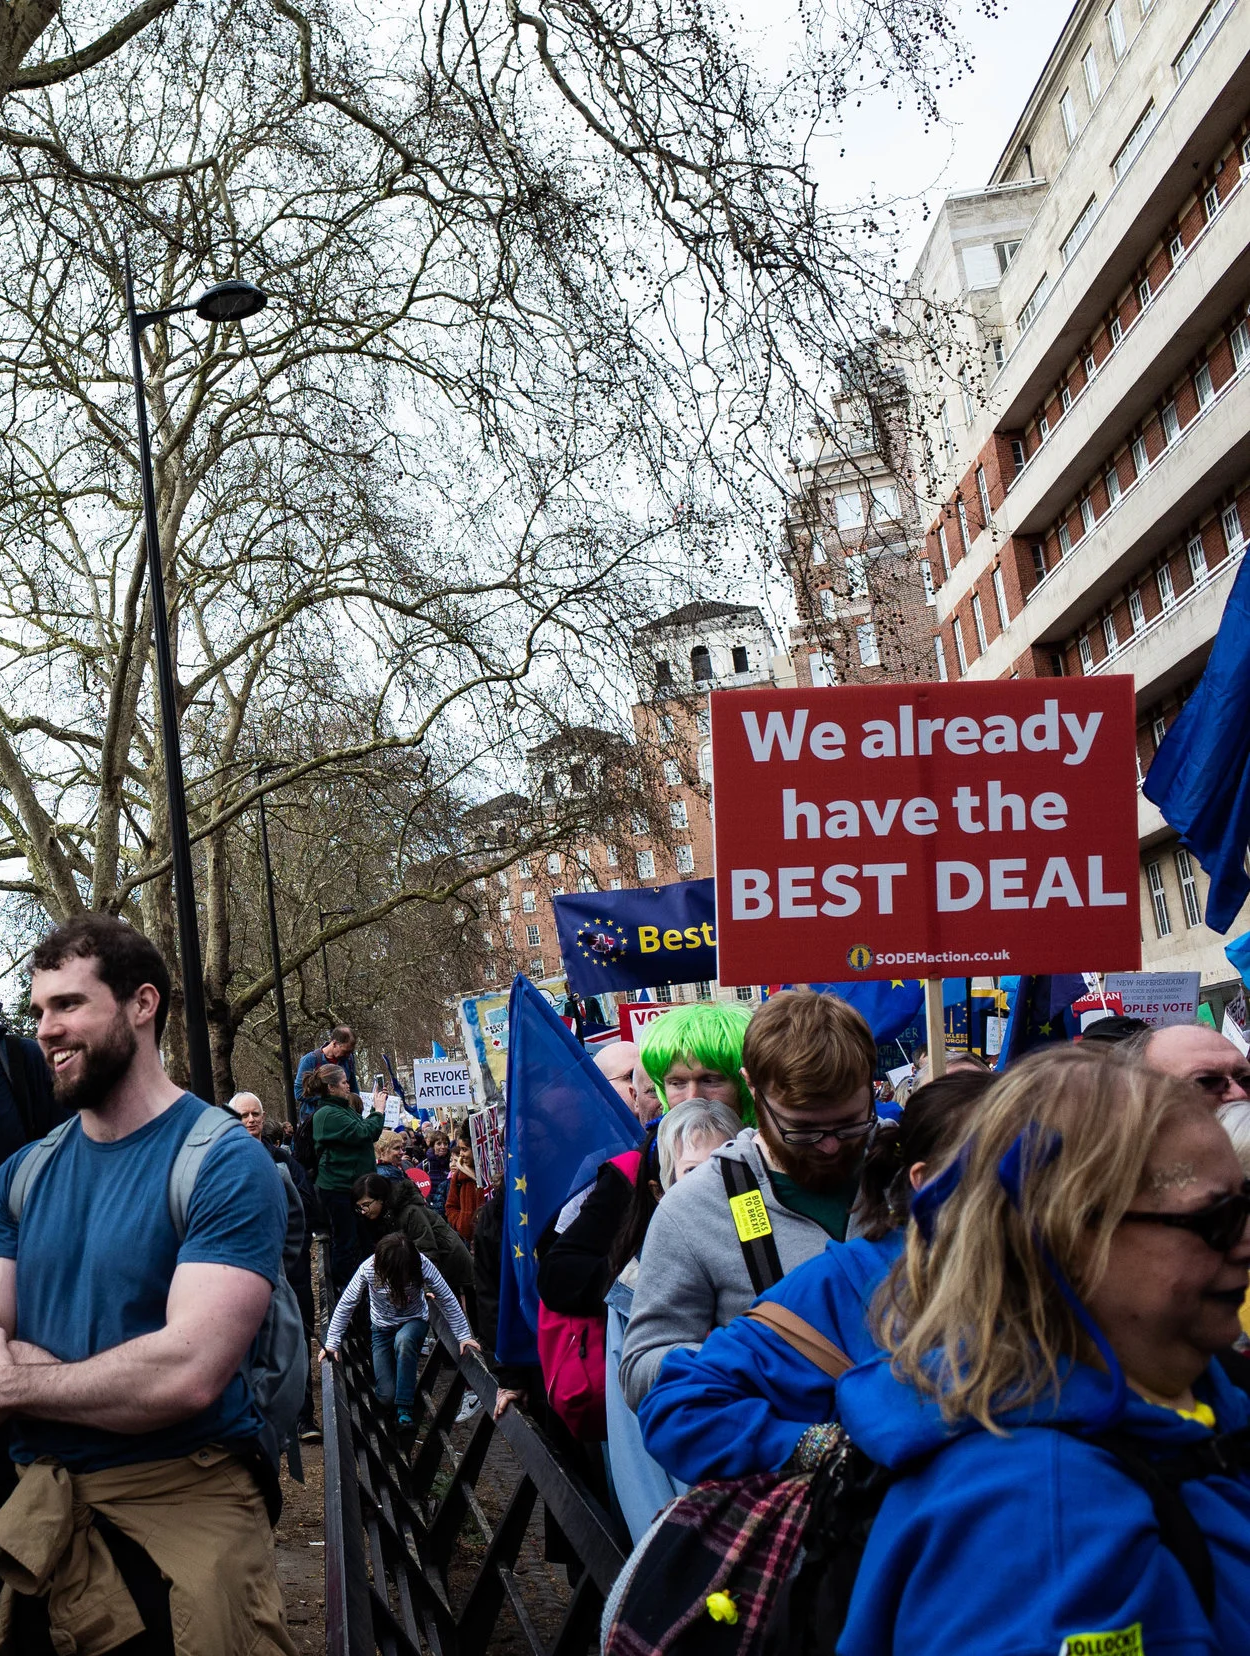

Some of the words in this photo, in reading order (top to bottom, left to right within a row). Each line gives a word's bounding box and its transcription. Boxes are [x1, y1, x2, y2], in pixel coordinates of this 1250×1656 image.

[741, 709, 846, 762] We
[861, 699, 1103, 765] already
[782, 788, 939, 840] have
[952, 780, 1068, 834] the
[731, 863, 907, 920] BEST
[936, 855, 1127, 912] DEAL
[638, 922, 717, 953] Best
[876, 949, 1010, 965] SODEMaction.co.uk
[1116, 979, 1134, 987] NEW
[1075, 993, 1120, 1002] ROPEAN
[1123, 1003, 1159, 1013] OPLES
[1162, 1003, 1193, 1013] VOTE
[424, 1069, 470, 1083] REVOKE
[419, 1085, 466, 1097] ARTICLE
[744, 1196, 752, 1207] TO
[751, 1195, 768, 1231] BOLLOCKS
[747, 1209, 761, 1234] BREXIT
